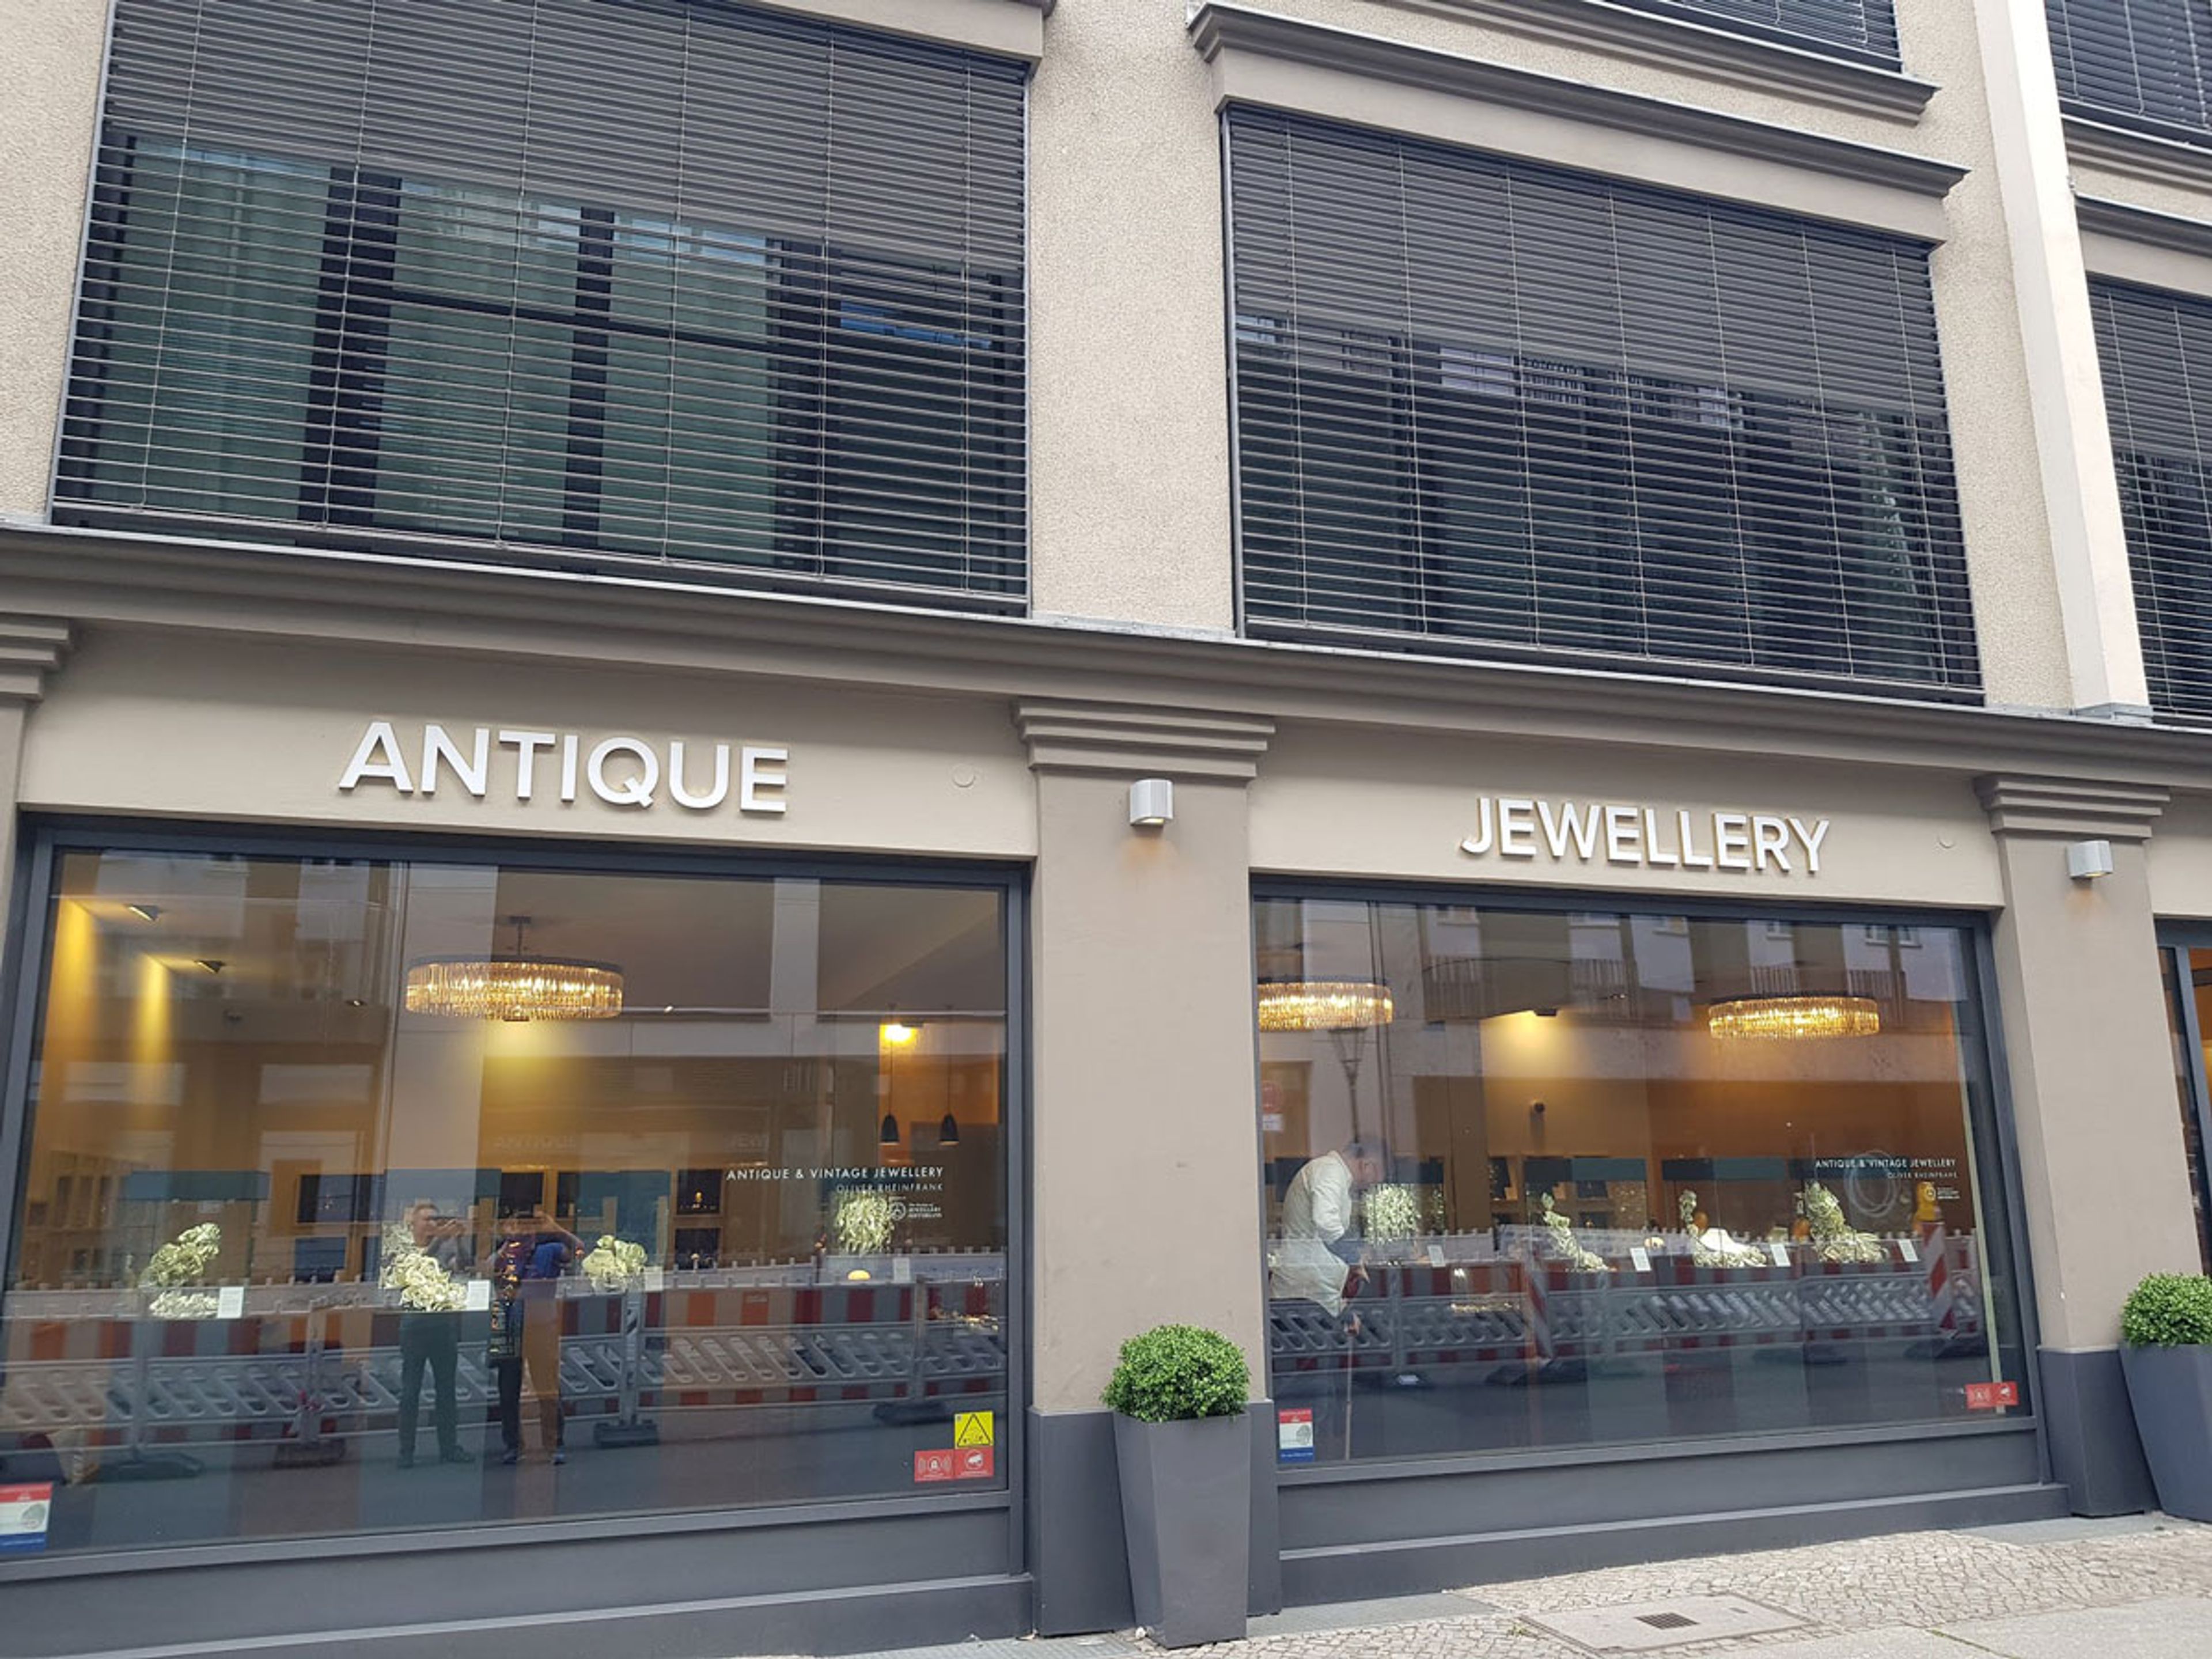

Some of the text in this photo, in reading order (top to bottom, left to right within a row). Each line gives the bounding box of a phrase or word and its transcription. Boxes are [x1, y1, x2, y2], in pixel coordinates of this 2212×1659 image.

[338, 721, 789, 813] ANTIQUE
[1460, 797, 1830, 872] JEWELLERY
[726, 1166, 944, 1181] ANTIQUE & VINTAGE JEWELLERY
[1815, 1158, 1855, 1168] ANTIQUE
[1868, 1158, 1907, 1168] VINTAGE
[1910, 1157, 1956, 1168] JEWELLERY
